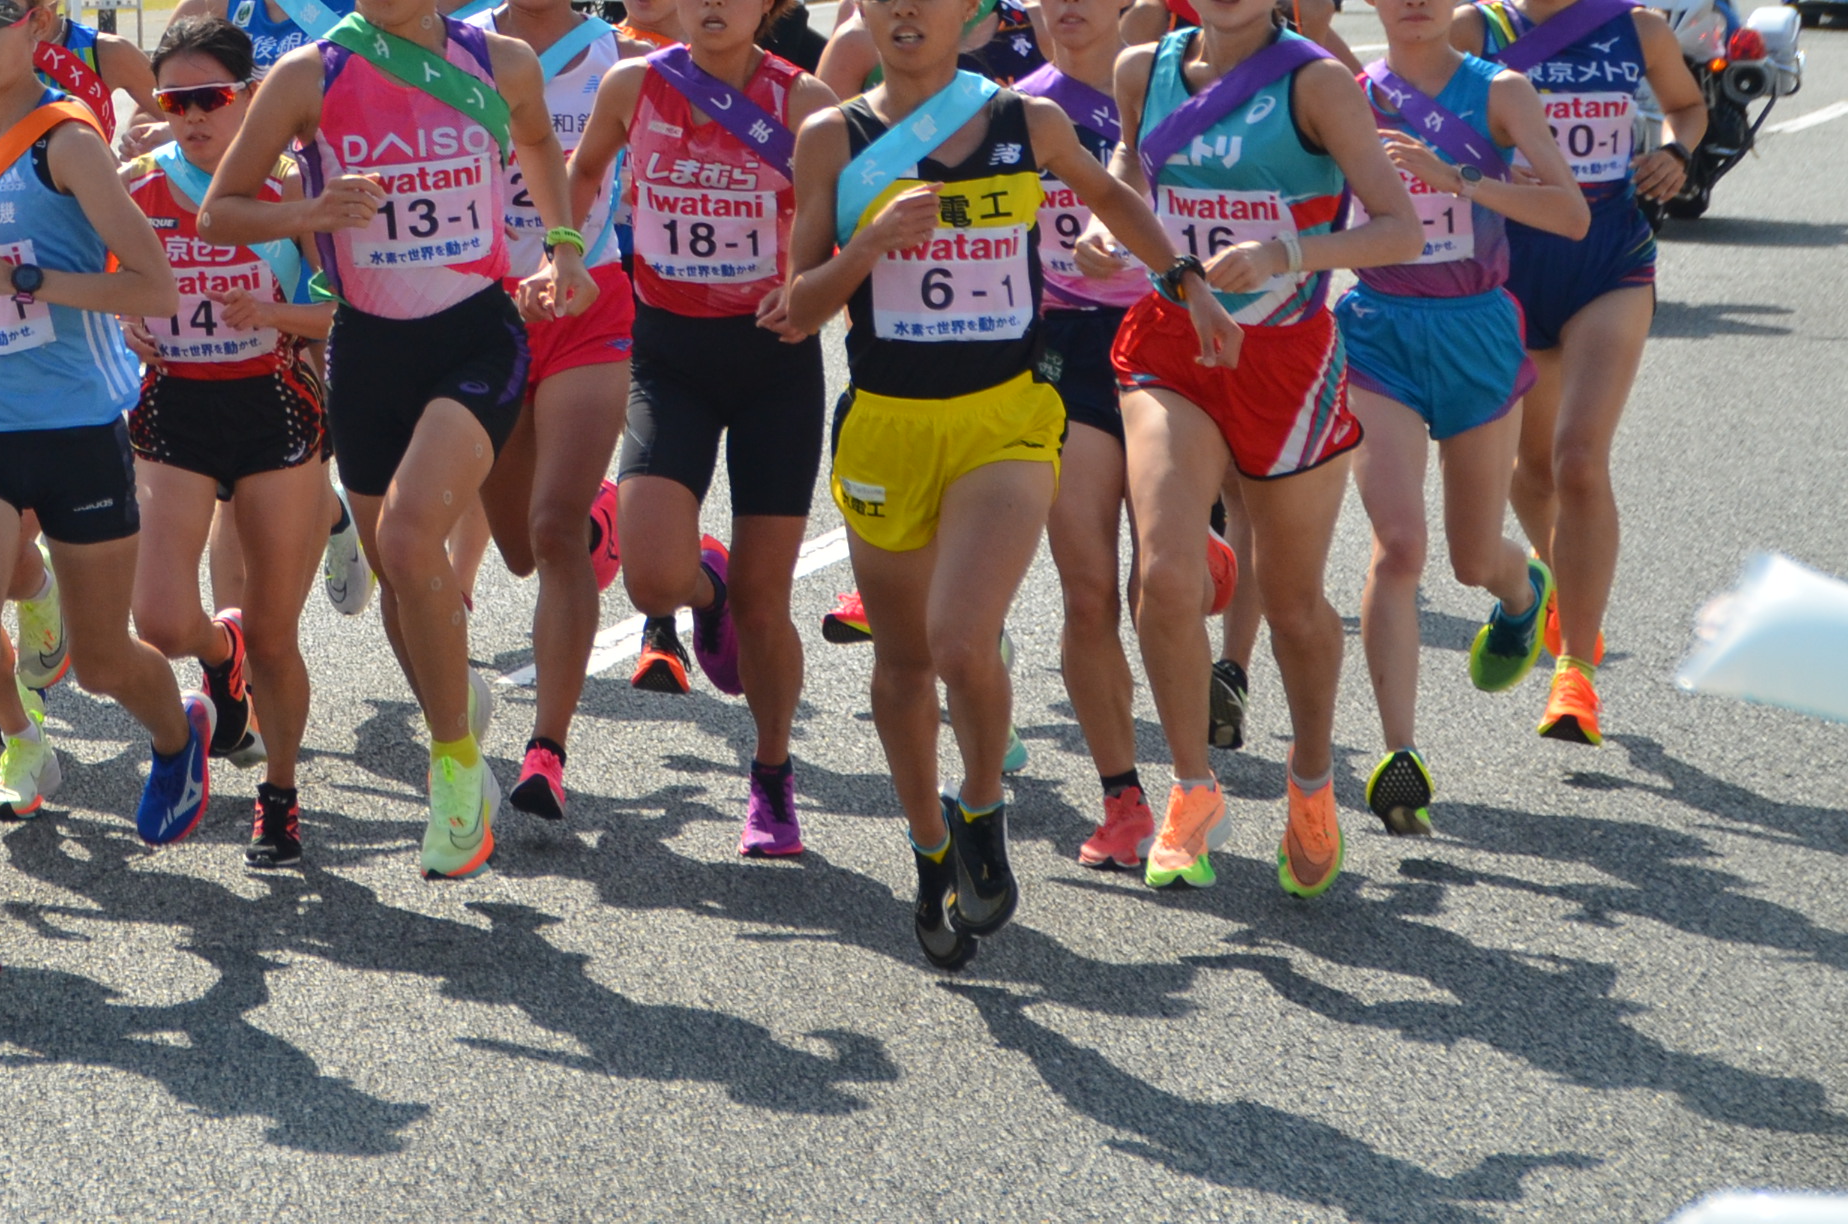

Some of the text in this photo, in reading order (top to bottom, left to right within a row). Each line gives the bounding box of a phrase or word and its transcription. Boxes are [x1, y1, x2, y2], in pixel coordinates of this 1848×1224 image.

[1389, 88, 1482, 160] スター
[1545, 97, 1629, 119] atani
[377, 158, 482, 195] watani
[645, 152, 759, 190] しまむら
[377, 197, 480, 241] 13-1
[646, 186, 764, 219] Iwatani
[939, 190, 1013, 228] 電工
[1167, 188, 1280, 221] Iwatani
[662, 219, 760, 258] 18-1
[176, 268, 261, 295] atani
[920, 267, 1015, 311] 6-1
